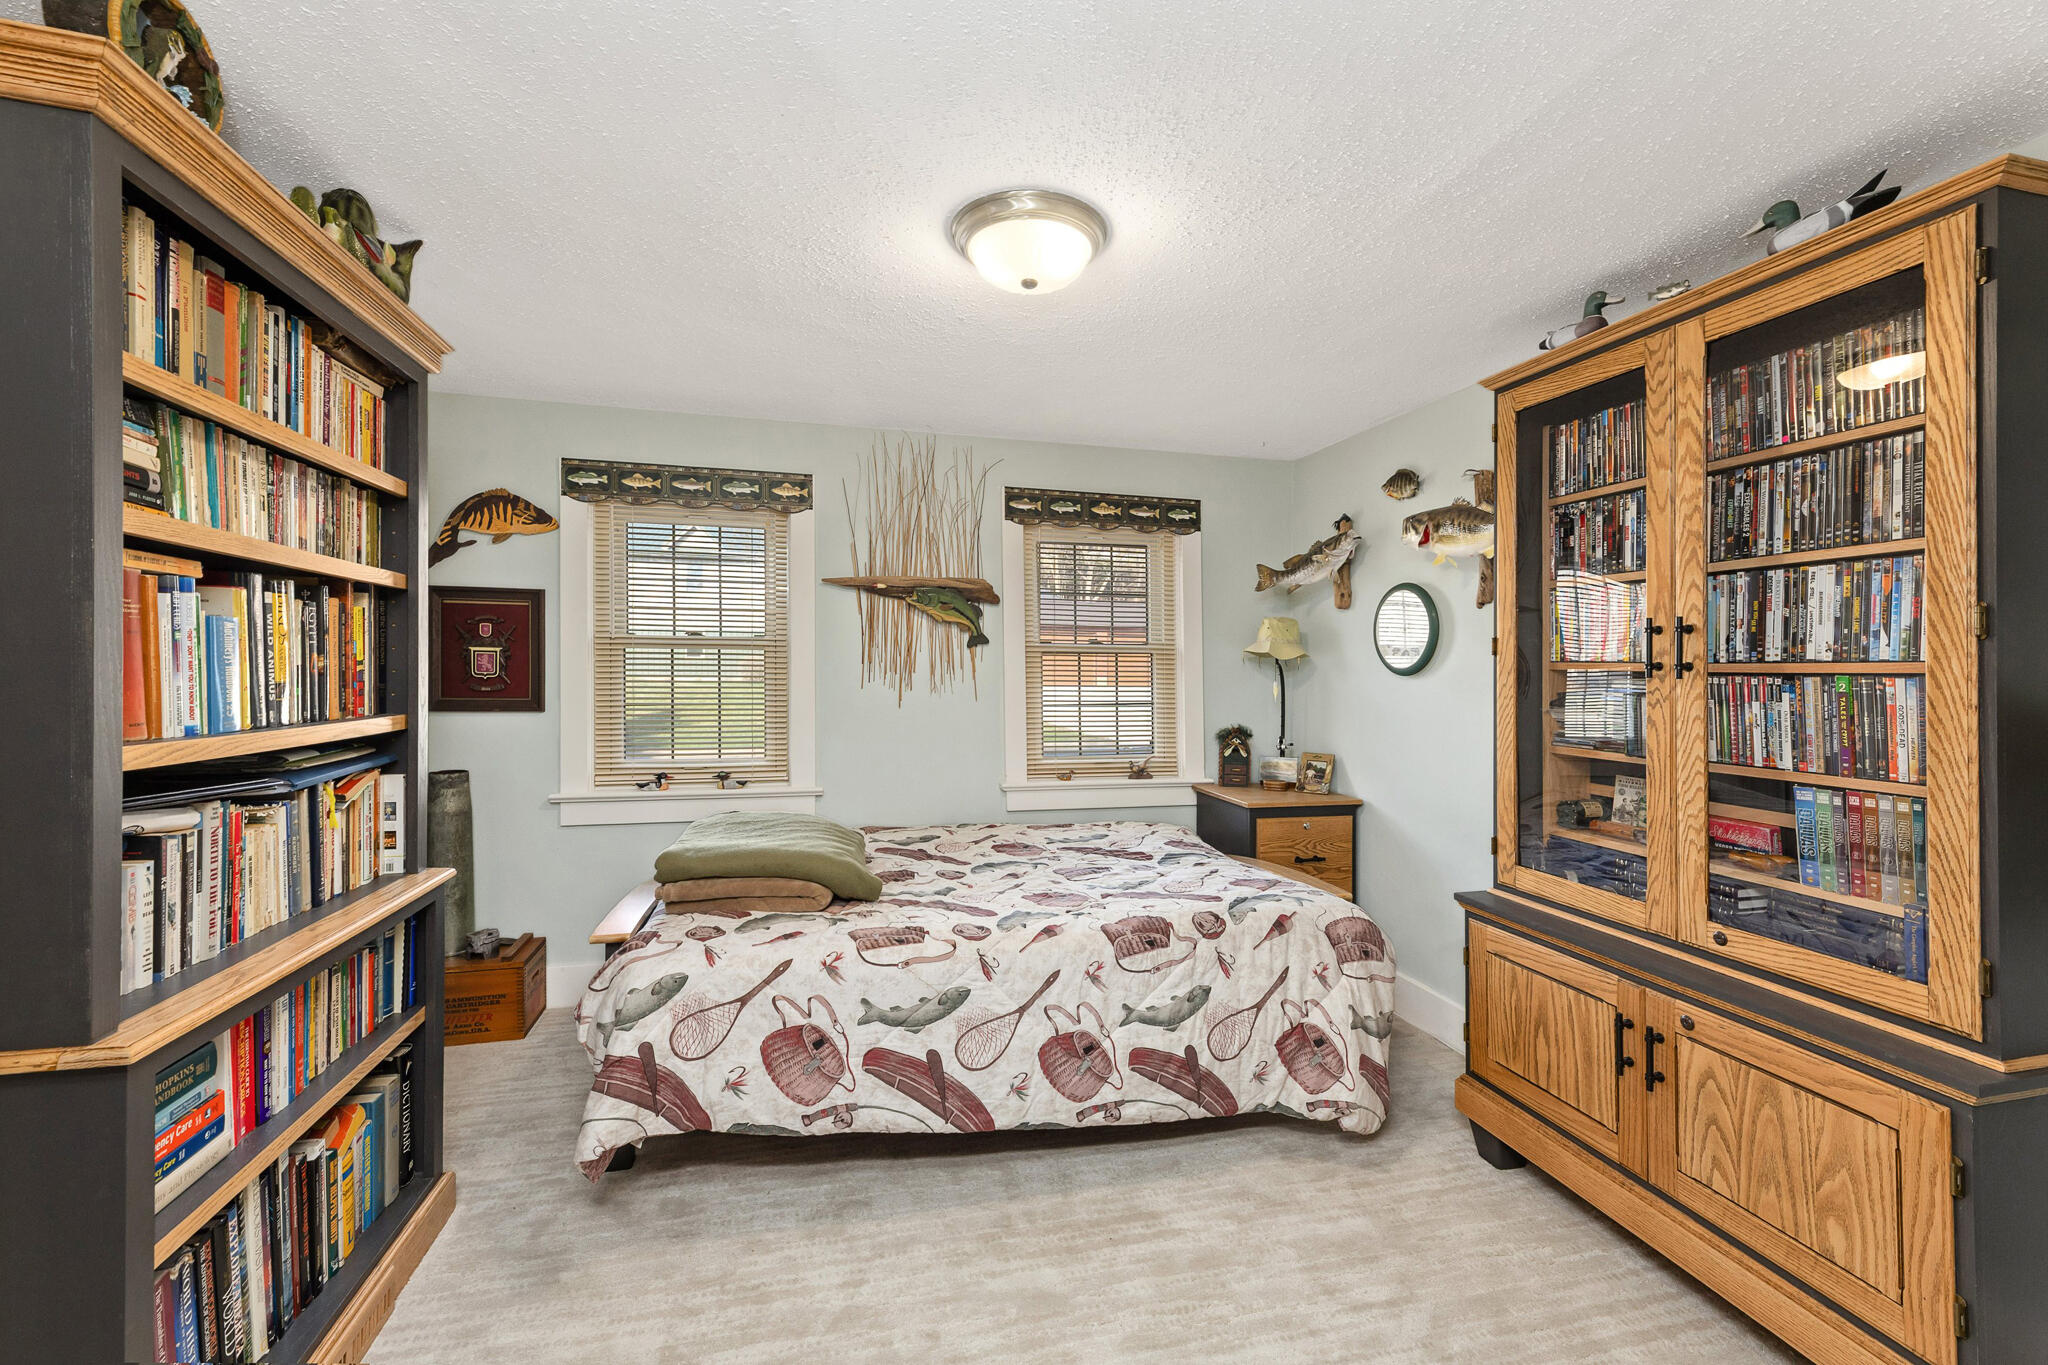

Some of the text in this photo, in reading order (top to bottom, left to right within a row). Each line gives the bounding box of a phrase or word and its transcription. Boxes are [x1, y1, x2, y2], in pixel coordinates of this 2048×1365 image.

[1914, 461, 1923, 506] TOTAL RECALL
[309, 607, 317, 644] EGYPT
[1839, 683, 1846, 692] 2
[1798, 808, 1816, 856] DALLAS
[1818, 811, 1832, 854] DALLAS
[1835, 813, 1844, 846] DALLAS
[1850, 812, 1860, 844] DALLAS
[1866, 815, 1878, 846] DALLAS
[1881, 818, 1893, 849] DALLAS
[1898, 820, 1911, 852] DALLAS
[160, 877, 167, 890] K2
[209, 826, 219, 938] NORTH TO THE POLE
[452, 994, 506, 1002] AMMUNITION
[156, 1063, 195, 1094] HOPKINS
[176, 1118, 193, 1136] Care
[402, 1080, 411, 1155] DICTIONARY
[182, 1260, 192, 1326] WORLD
[204, 1239, 214, 1295] EXPLORING
[210, 1318, 218, 1358] WORLD
[229, 1218, 244, 1359] EXPLORE AMERICA
[156, 1298, 165, 1343] Timetables
[222, 1283, 236, 1356] WORLD
